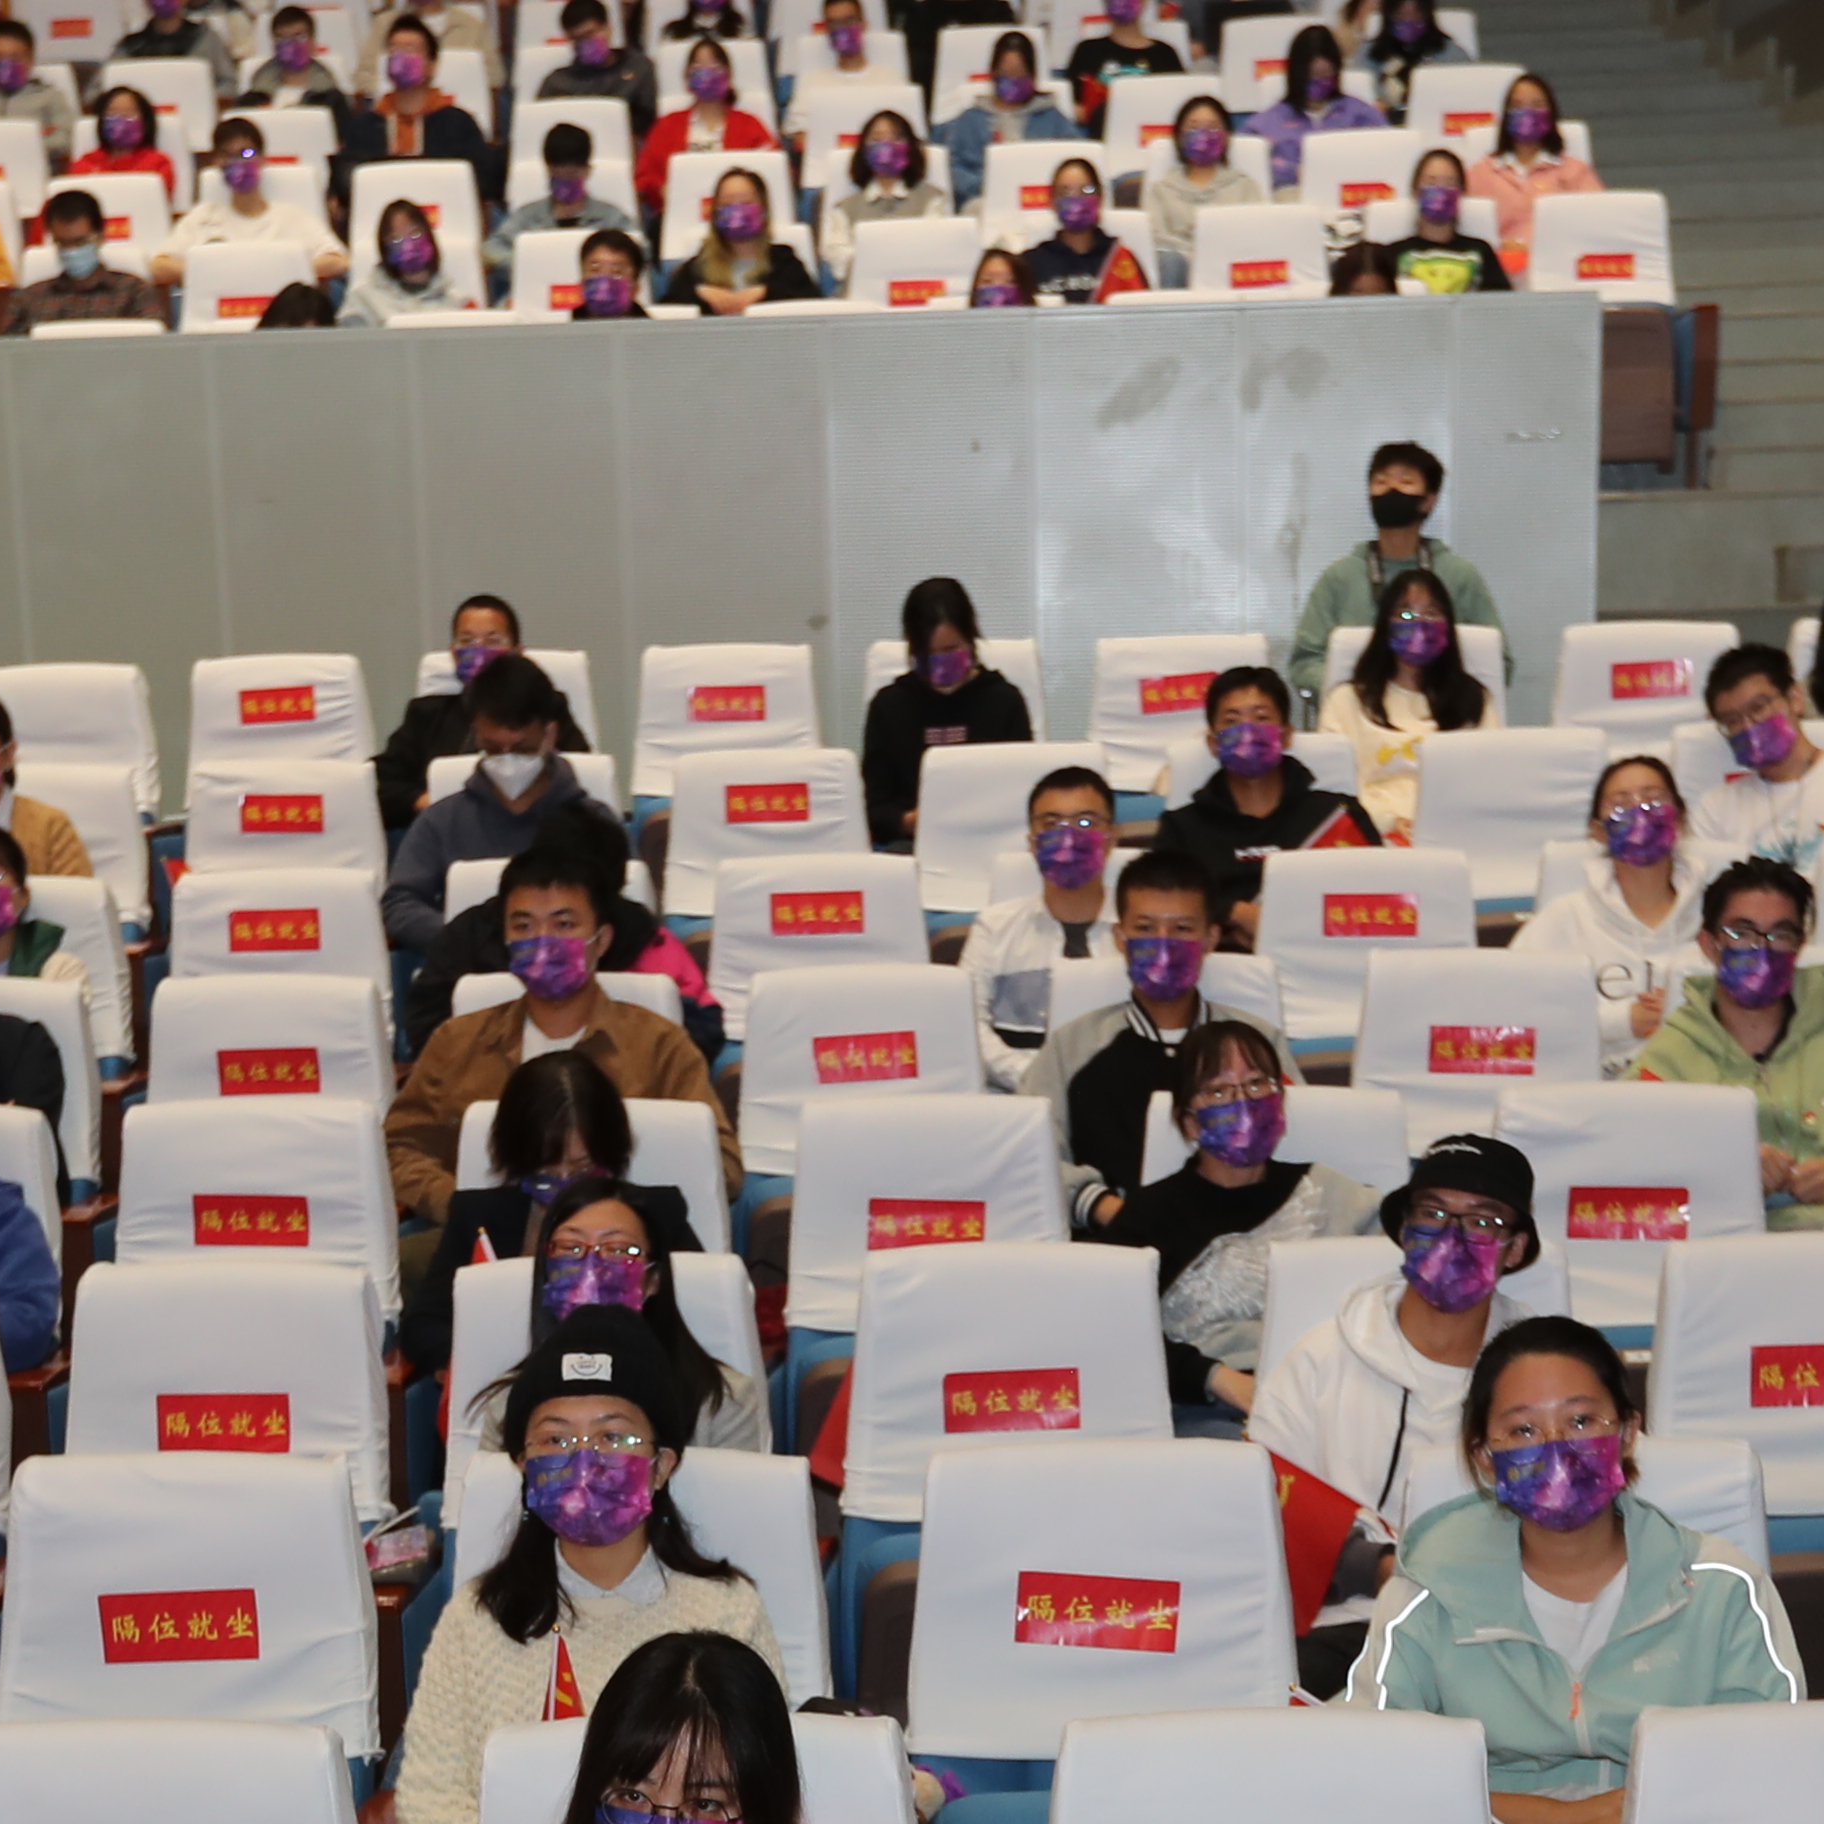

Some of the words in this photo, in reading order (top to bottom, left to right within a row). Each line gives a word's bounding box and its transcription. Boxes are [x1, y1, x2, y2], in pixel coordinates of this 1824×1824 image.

[200, 1209, 307, 1233] 隔位就坐
[876, 1214, 984, 1240] 隔位就坐
[951, 1385, 1077, 1416] 隔位就坐
[164, 1410, 288, 1439] 隔位就坐
[111, 1611, 256, 1643] 隔位就坐
[1026, 1593, 1175, 1631] 隔位就坐
